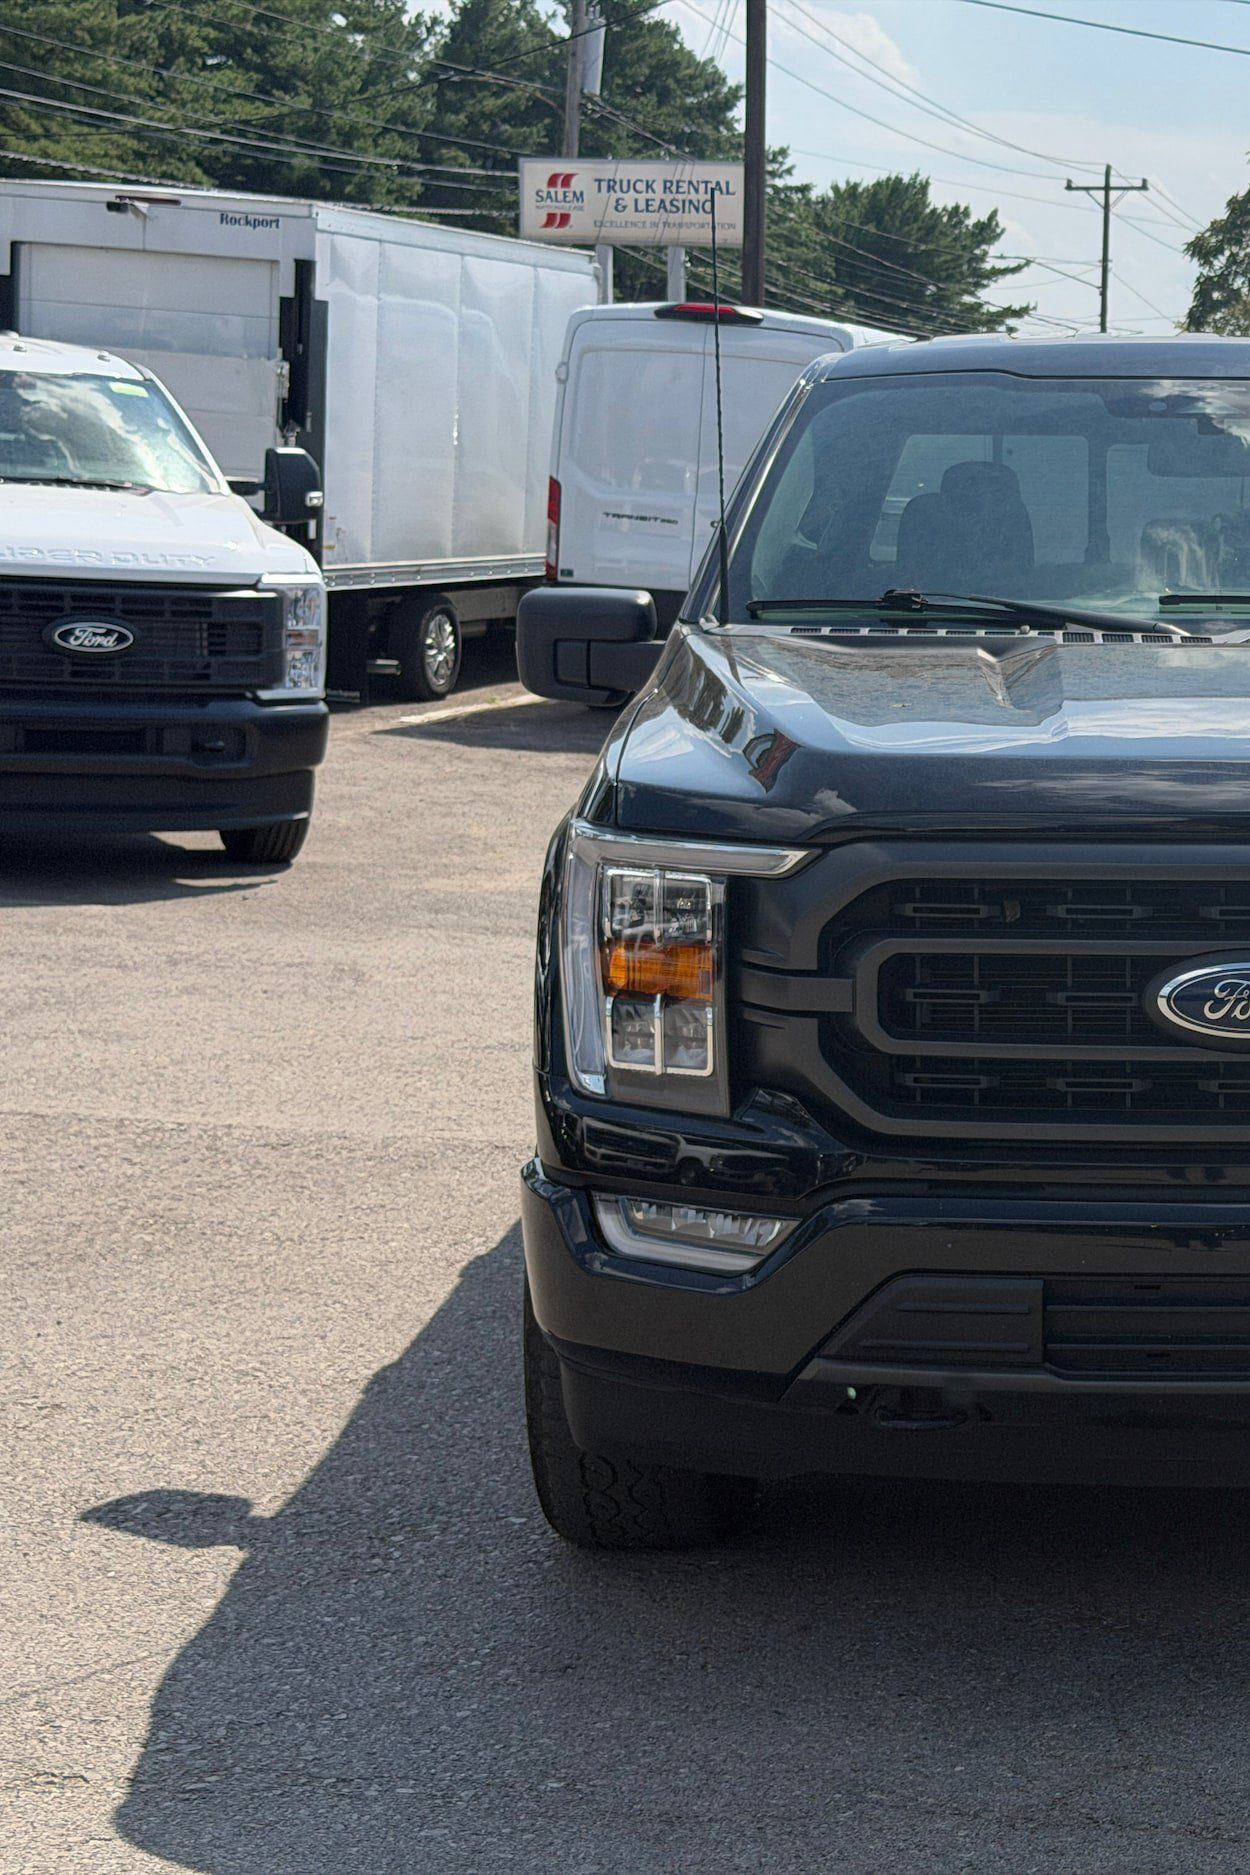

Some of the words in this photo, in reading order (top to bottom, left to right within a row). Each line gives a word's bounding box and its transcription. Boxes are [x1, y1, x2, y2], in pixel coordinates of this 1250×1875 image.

[594, 178, 656, 194] TRUCK
[663, 179, 736, 195] RENTAL
[535, 190, 584, 203] SALEM
[614, 198, 628, 213] &
[220, 213, 279, 230] Rockport
[662, 220, 736, 230] TRANSPORTTION
[111, 551, 215, 568] DUTY
[69, 626, 118, 648] Ford
